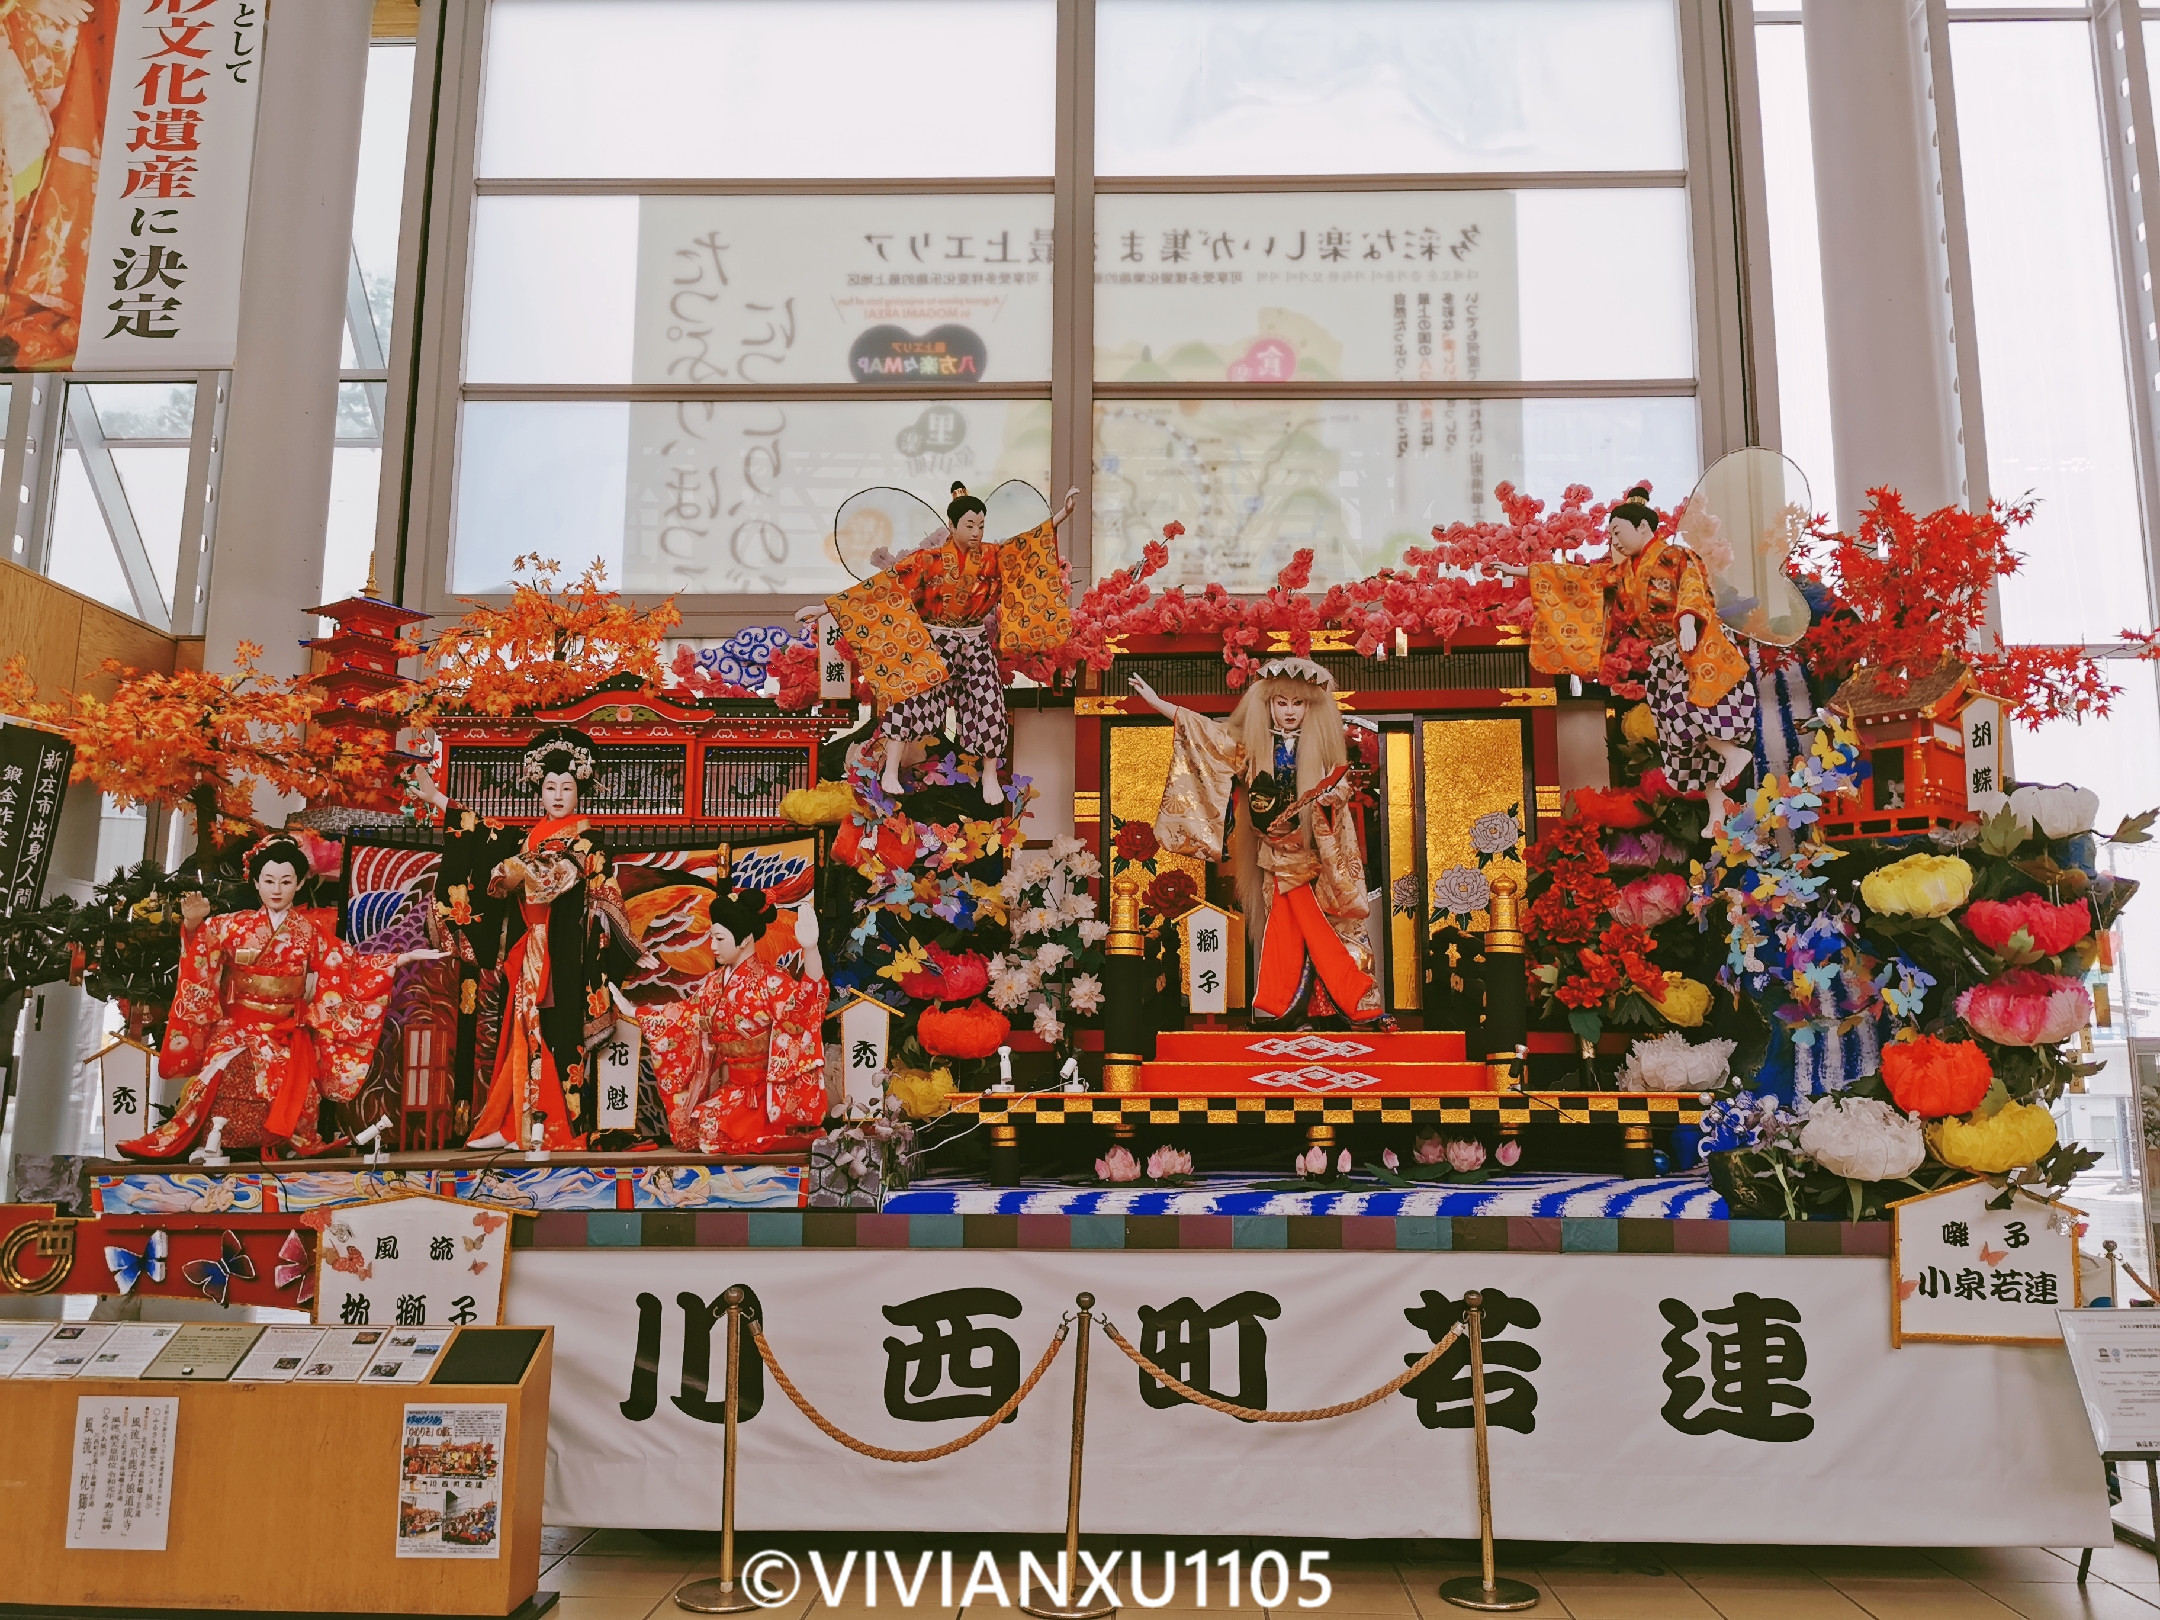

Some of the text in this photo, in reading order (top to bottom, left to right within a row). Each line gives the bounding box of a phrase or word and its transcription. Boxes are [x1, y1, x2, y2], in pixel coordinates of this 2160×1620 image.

[226, 3, 256, 84] として
[1971, 720, 1993, 793] 胡蝶
[1196, 928, 1220, 993] 獅子
[606, 1040, 630, 1110] 花魁
[374, 1235, 455, 1261] 風流
[1918, 1265, 2059, 1305] 小泉若連
[619, 1285, 1815, 1443] 川西町若連
